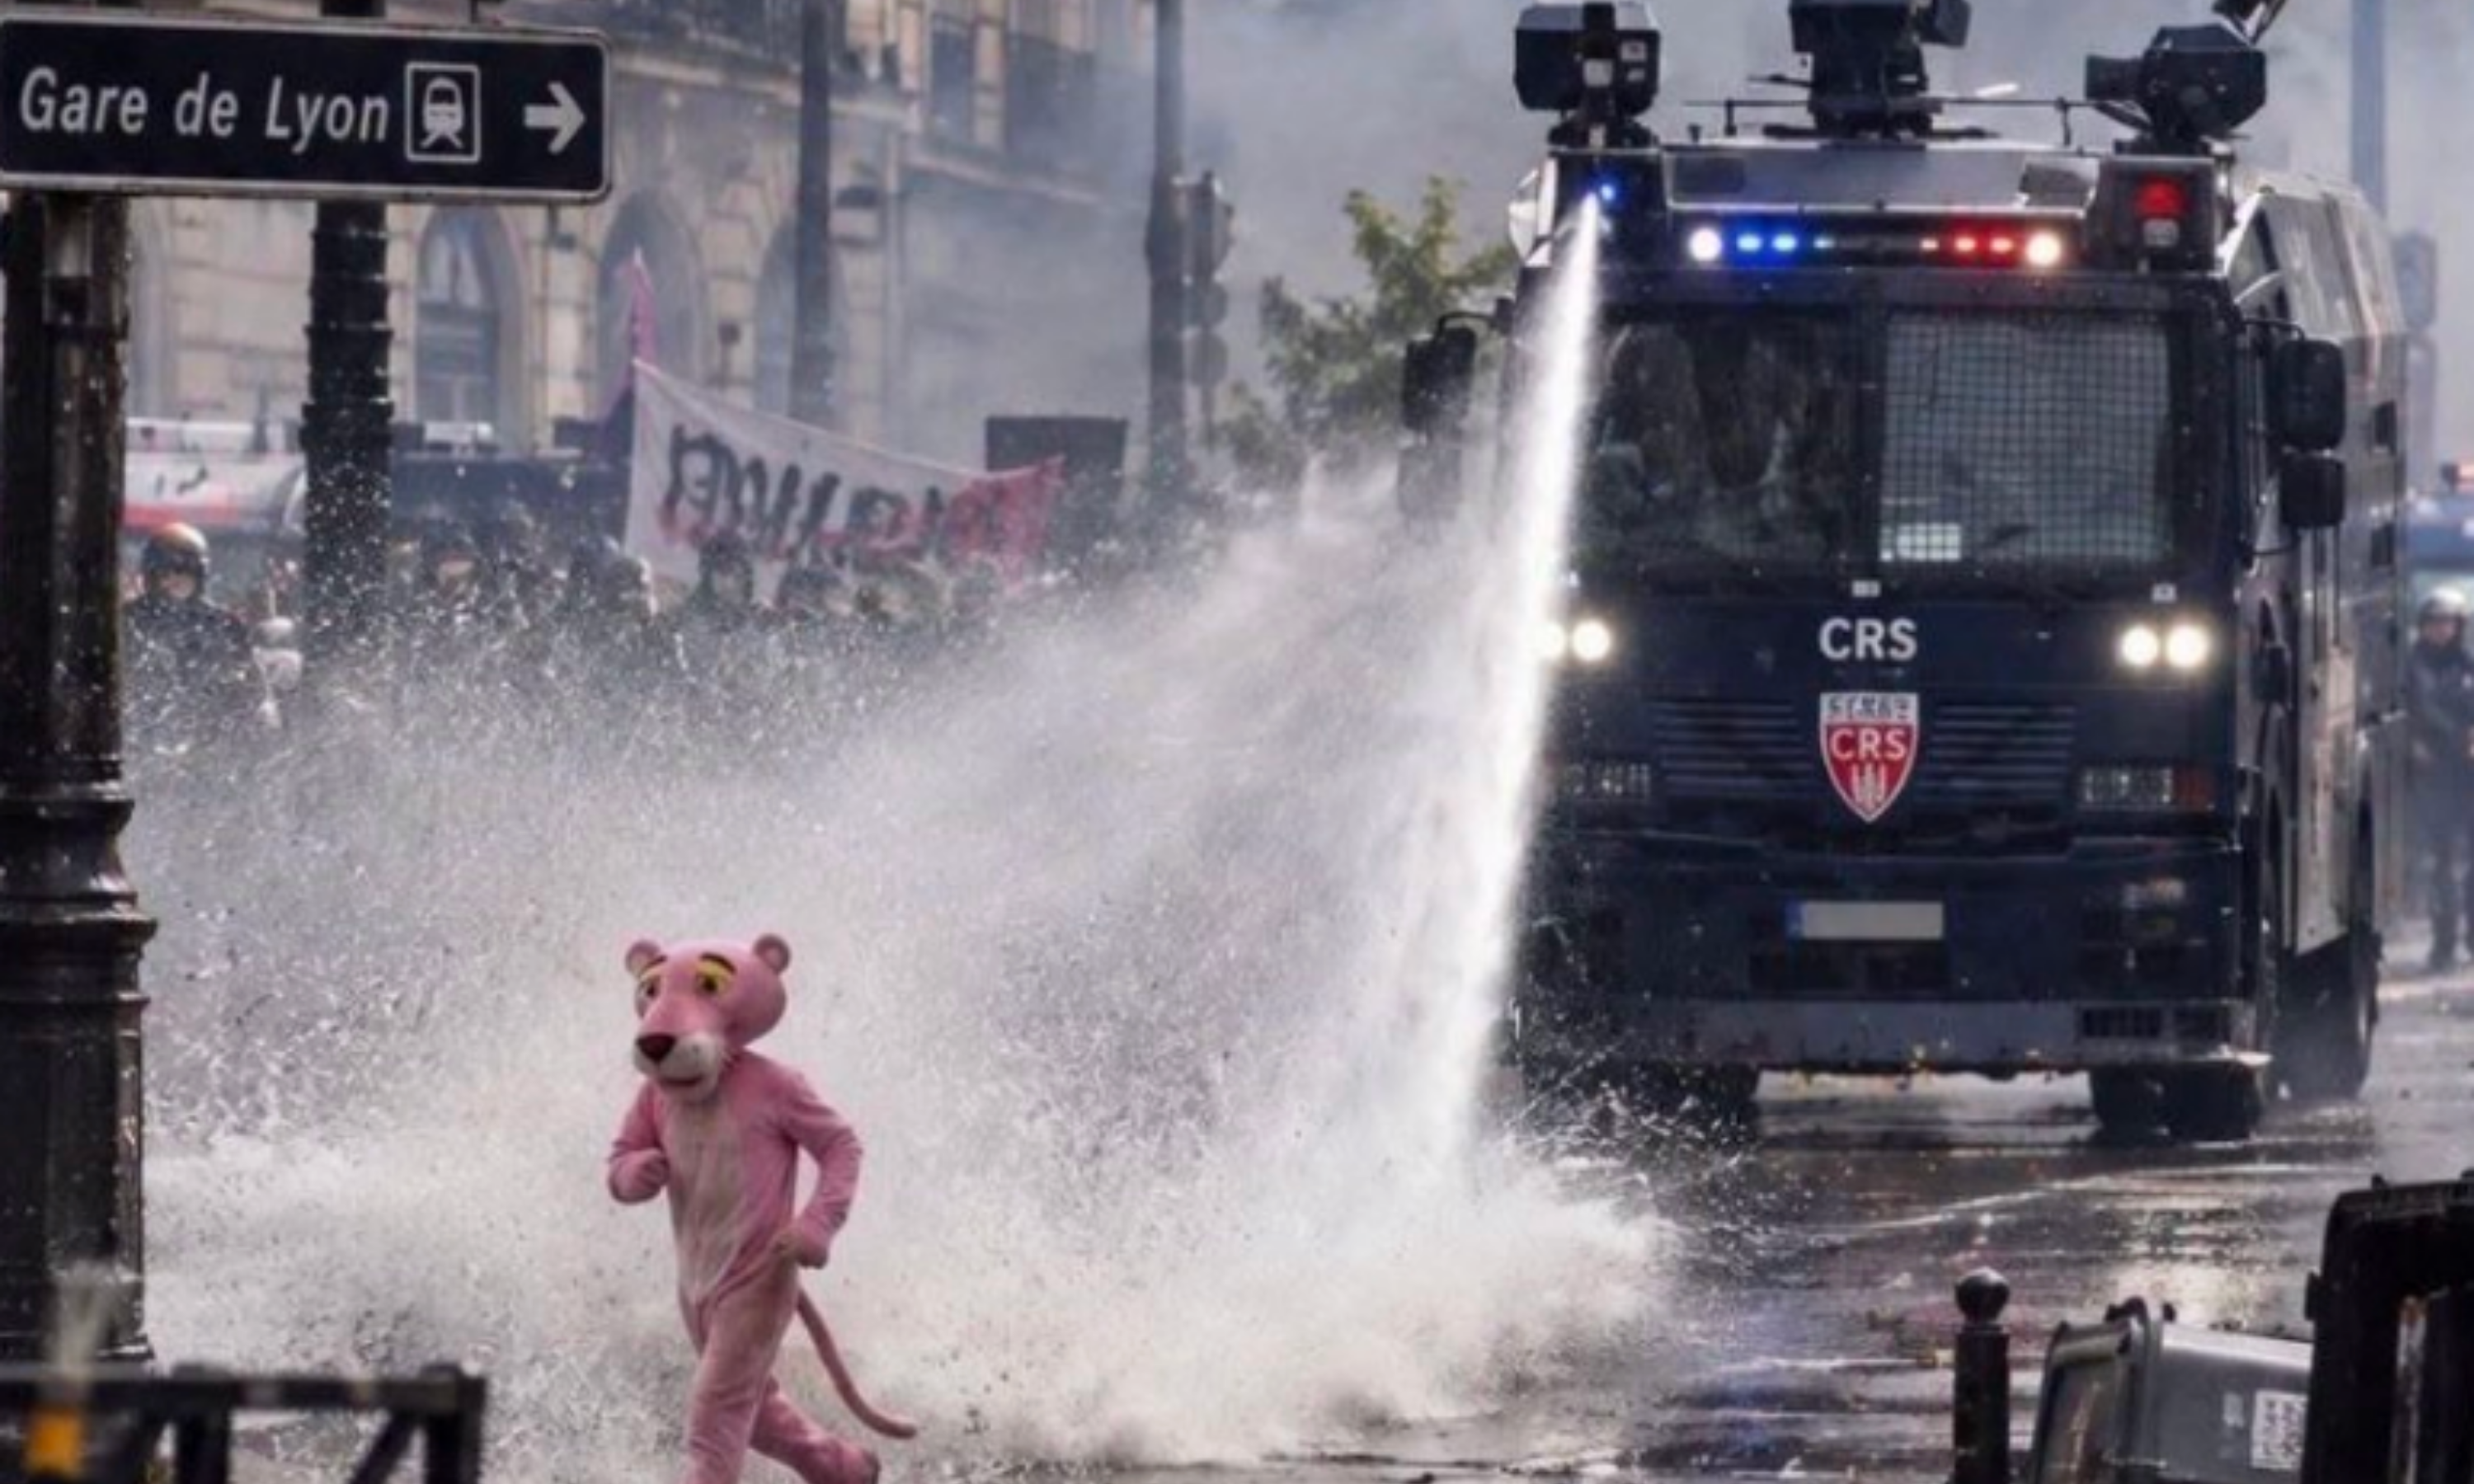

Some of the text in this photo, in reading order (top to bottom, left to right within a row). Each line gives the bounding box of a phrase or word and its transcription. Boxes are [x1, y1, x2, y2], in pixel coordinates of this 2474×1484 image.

[19, 66, 389, 155] Gare de Lyon
[1819, 616, 1918, 660] CRS
[1829, 726, 1907, 761] CRS
